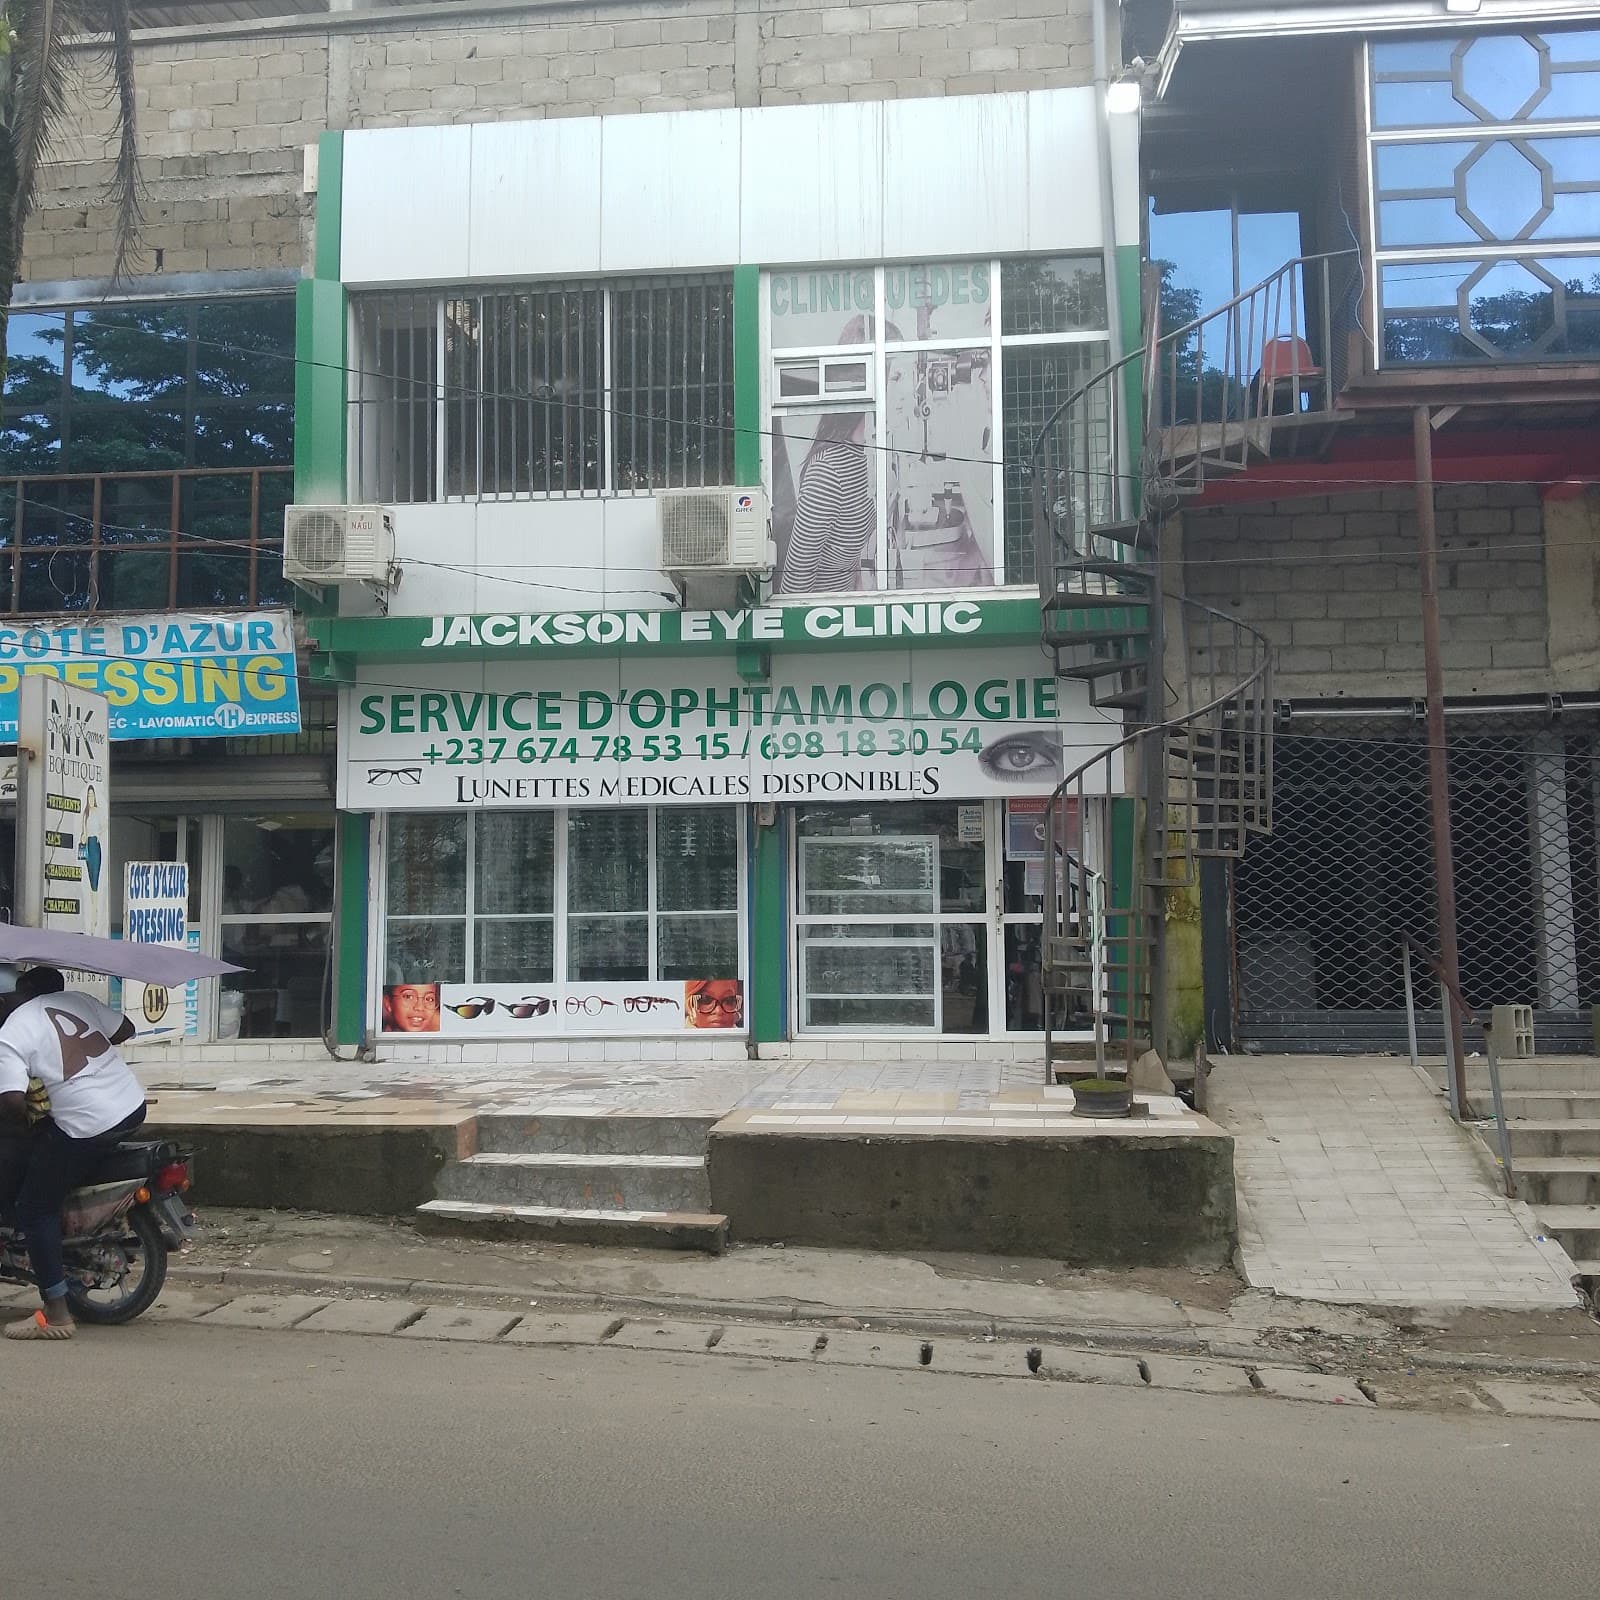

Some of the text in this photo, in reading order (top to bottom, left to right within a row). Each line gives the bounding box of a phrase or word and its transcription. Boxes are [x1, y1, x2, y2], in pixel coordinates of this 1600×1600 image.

[122, 620, 278, 656] D'AZUR
[421, 602, 983, 647] JACKSON EYE CLINIC
[139, 715, 216, 730] LAVOMATIC
[245, 711, 298, 726] EXPRESS
[360, 677, 1060, 735] SERVICE D'OPHTAMOLOGIE
[422, 726, 983, 766] +237 674 78 53 15 / 698 18 30 54
[48, 755, 103, 784] BOUTIQUE
[455, 766, 940, 804] LUNETTES MEDICALES DISPONIBLES
[153, 863, 186, 900] D'AZUR
[129, 907, 184, 944] PRESSING
